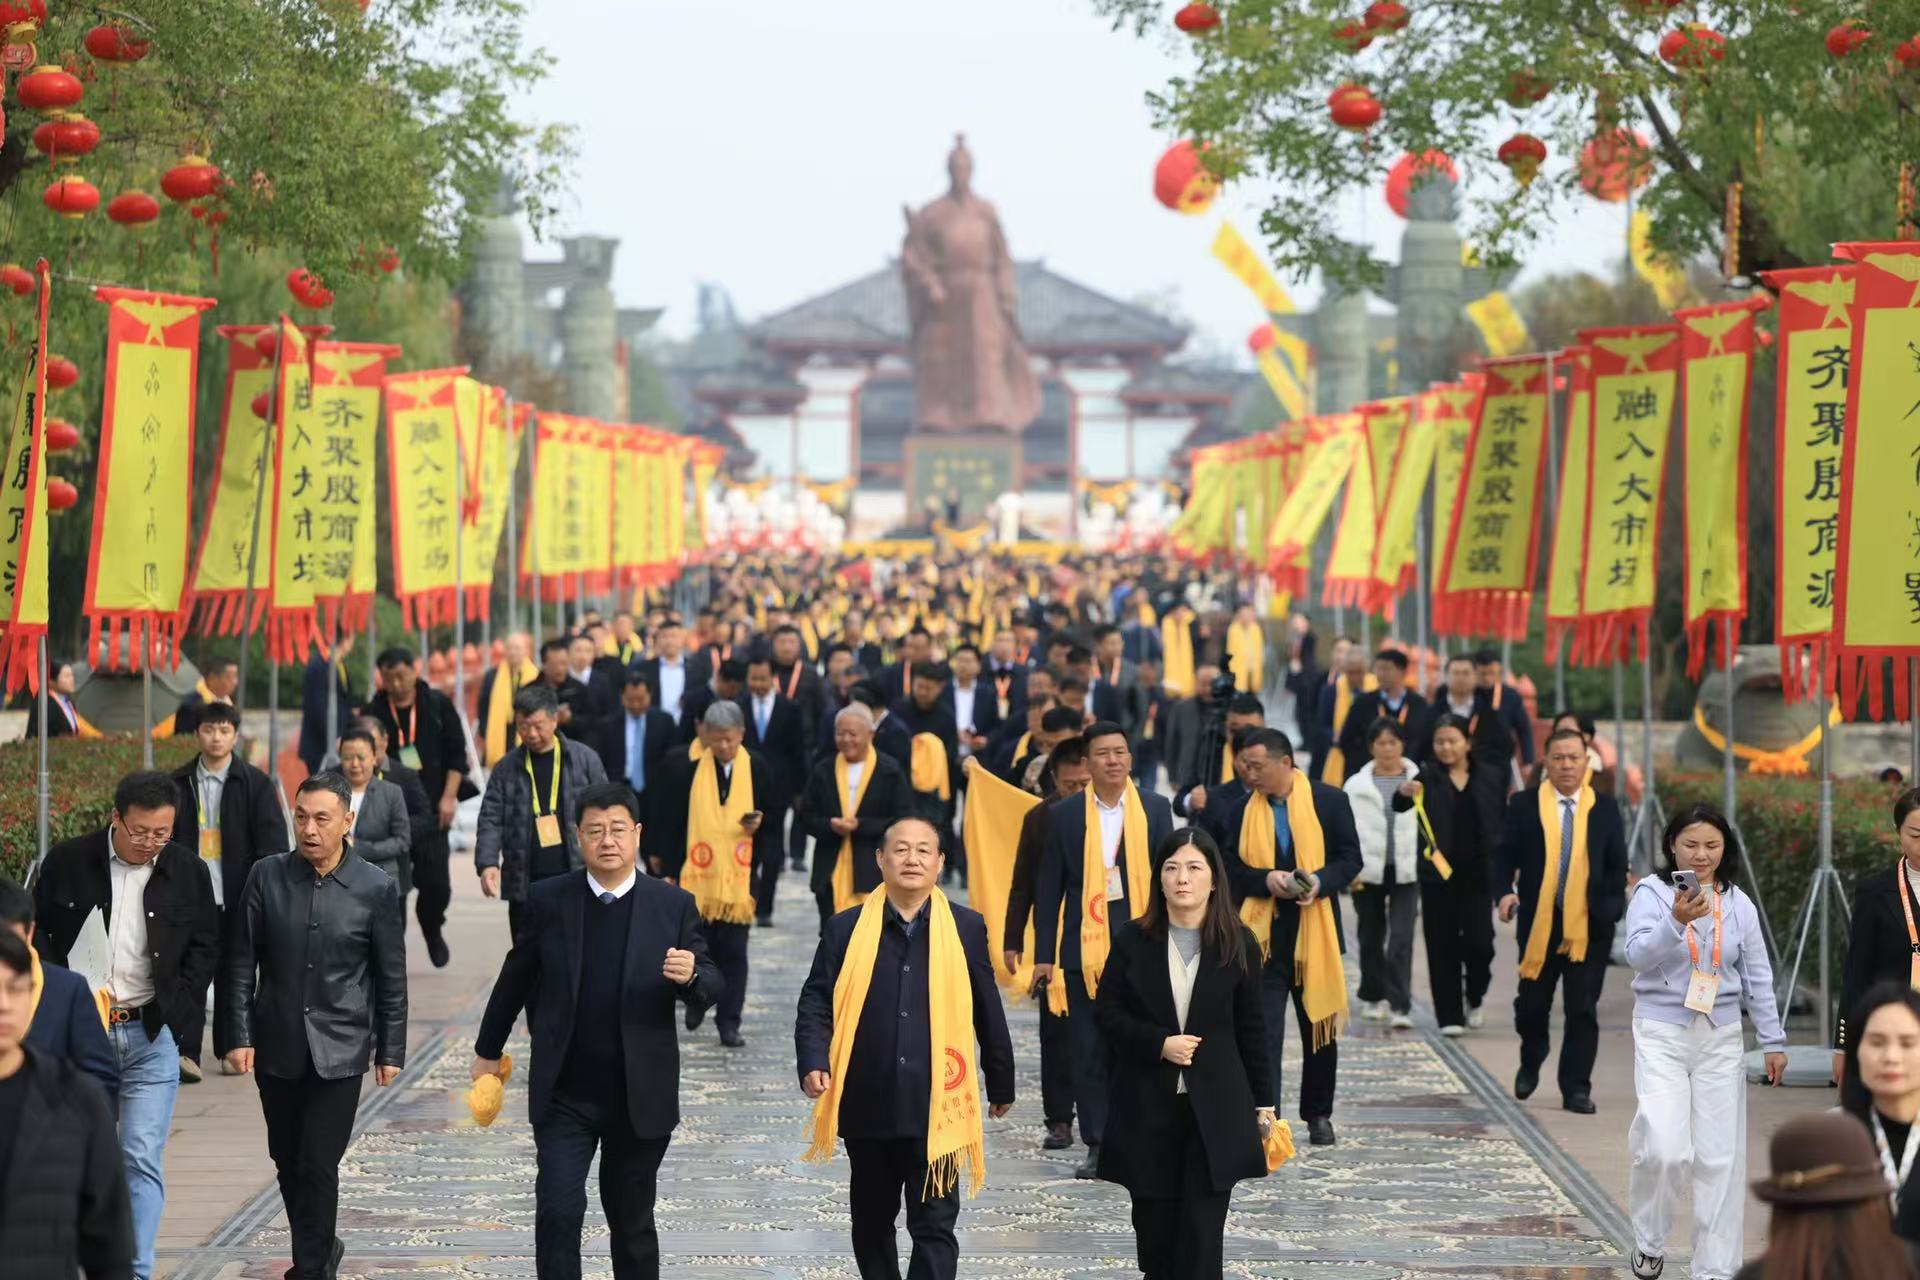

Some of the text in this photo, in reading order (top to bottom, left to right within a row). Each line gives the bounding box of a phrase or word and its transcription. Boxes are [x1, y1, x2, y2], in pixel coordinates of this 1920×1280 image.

[1608, 386, 1657, 585] 融入大市场
